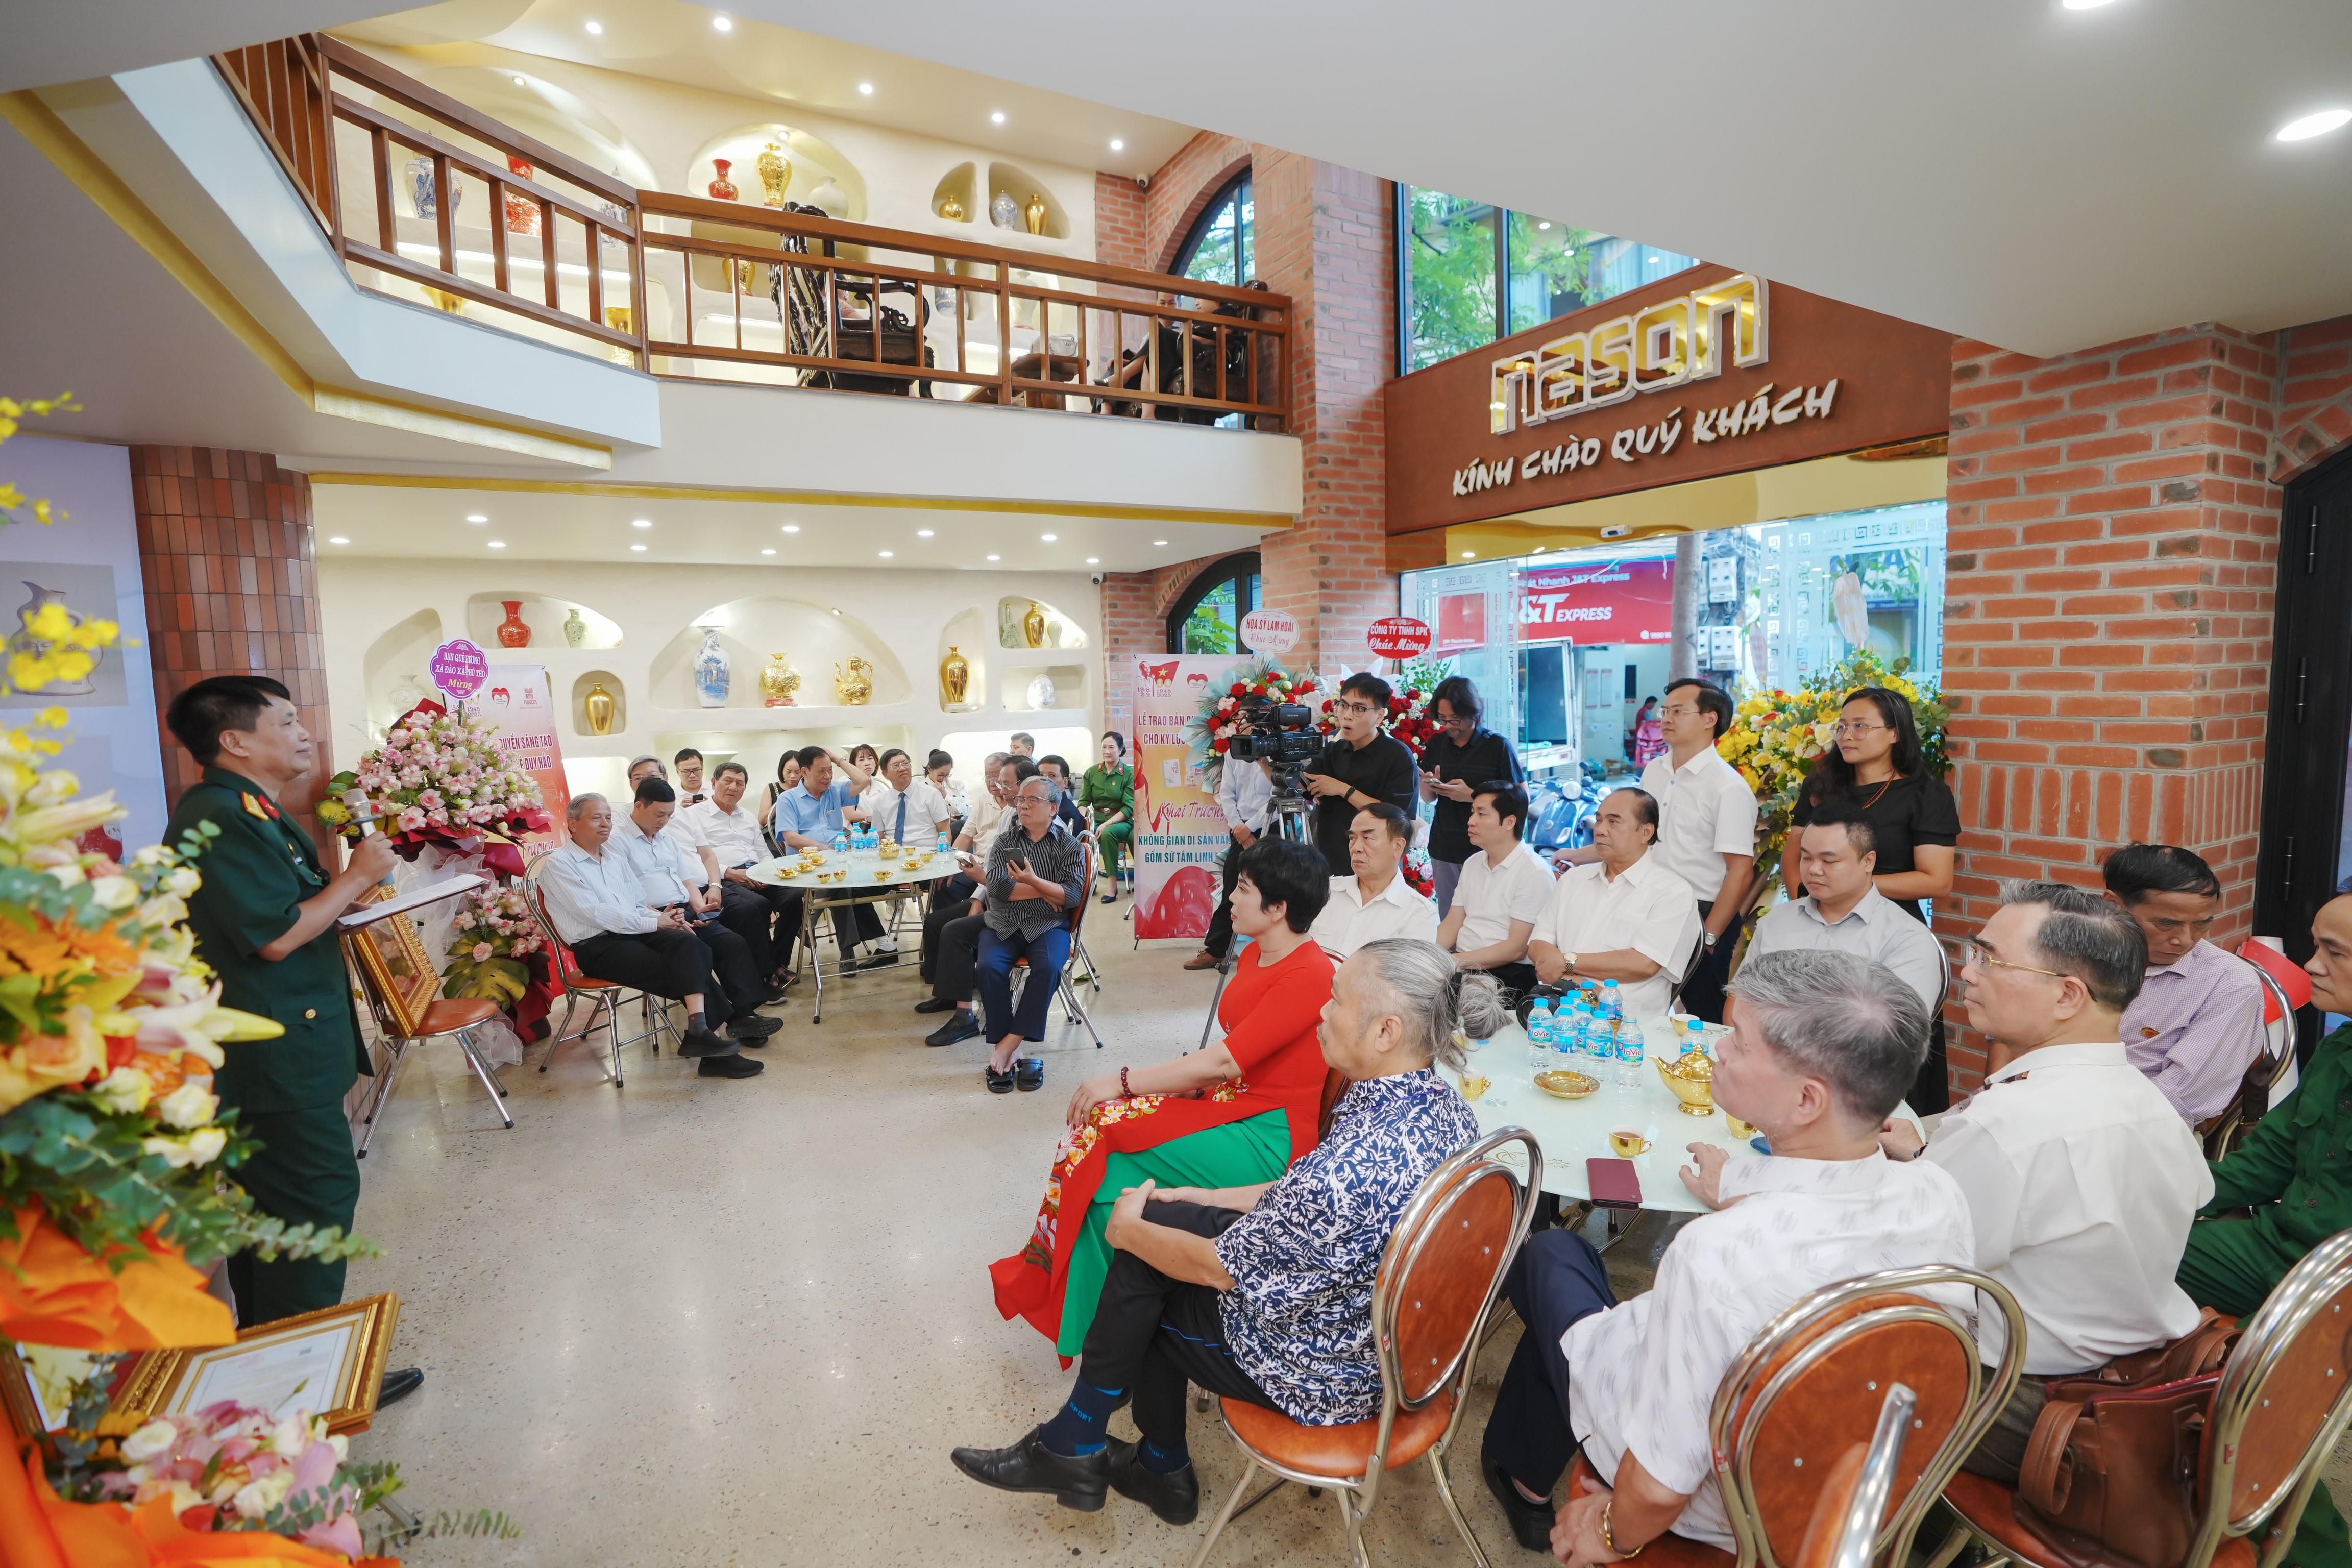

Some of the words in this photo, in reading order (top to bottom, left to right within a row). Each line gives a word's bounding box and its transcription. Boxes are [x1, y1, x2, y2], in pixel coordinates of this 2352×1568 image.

[1490, 273, 1769, 435] nason
[1452, 457, 1514, 497] KÍNH
[1521, 434, 1601, 480] CHÀO
[1611, 406, 1682, 462] QUÝ
[1692, 378, 1838, 444] KHÁCH
[1538, 575, 1570, 586] Nhanh
[1590, 573, 1630, 584] Express
[1556, 606, 1613, 622] EXPRESS
[1246, 618, 1257, 632] HỌA
[1259, 618, 1266, 630] SỸ
[1267, 620, 1280, 631] LAM
[1370, 623, 1387, 635] CÔNG
[1389, 626, 1398, 635] TY
[1398, 626, 1414, 635] TNHH
[1415, 626, 1428, 636] SPK
[1369, 637, 1393, 650] Chúc
[1394, 638, 1426, 654] Mừng
[444, 652, 454, 663] BẠN
[455, 652, 464, 663] QUÊ
[465, 655, 480, 665] HƯƠNG
[435, 663, 443, 673] XÃ
[445, 664, 456, 674] ĐÀO
[476, 670, 485, 679] THỌ
[448, 679, 473, 691] Mừng
[1138, 711, 1146, 726] LỄ
[1148, 716, 1167, 726] TRAO
[1169, 712, 1184, 726] BẢN
[522, 734, 540, 749] SÁNG
[540, 734, 552, 750] TẠO
[1144, 734, 1160, 744] CHO
[1161, 730, 1170, 745] KỶ
[525, 757, 538, 770] DUY
[538, 752, 552, 769] HẢO
[1160, 802, 1187, 821] Khai
[1138, 833, 1164, 845] KHÔNG
[1166, 835, 1185, 845] GIAN
[1188, 835, 1195, 845] DI
[1197, 832, 1213, 845] SẢN
[1215, 832, 1231, 845] VĂN
[1145, 849, 1162, 863] GỐM
[1164, 851, 1175, 862] SỨ
[1177, 850, 1193, 862] TÂM
[1195, 852, 1213, 862] LINH
[1070, 1401, 1093, 1423] SPORT
